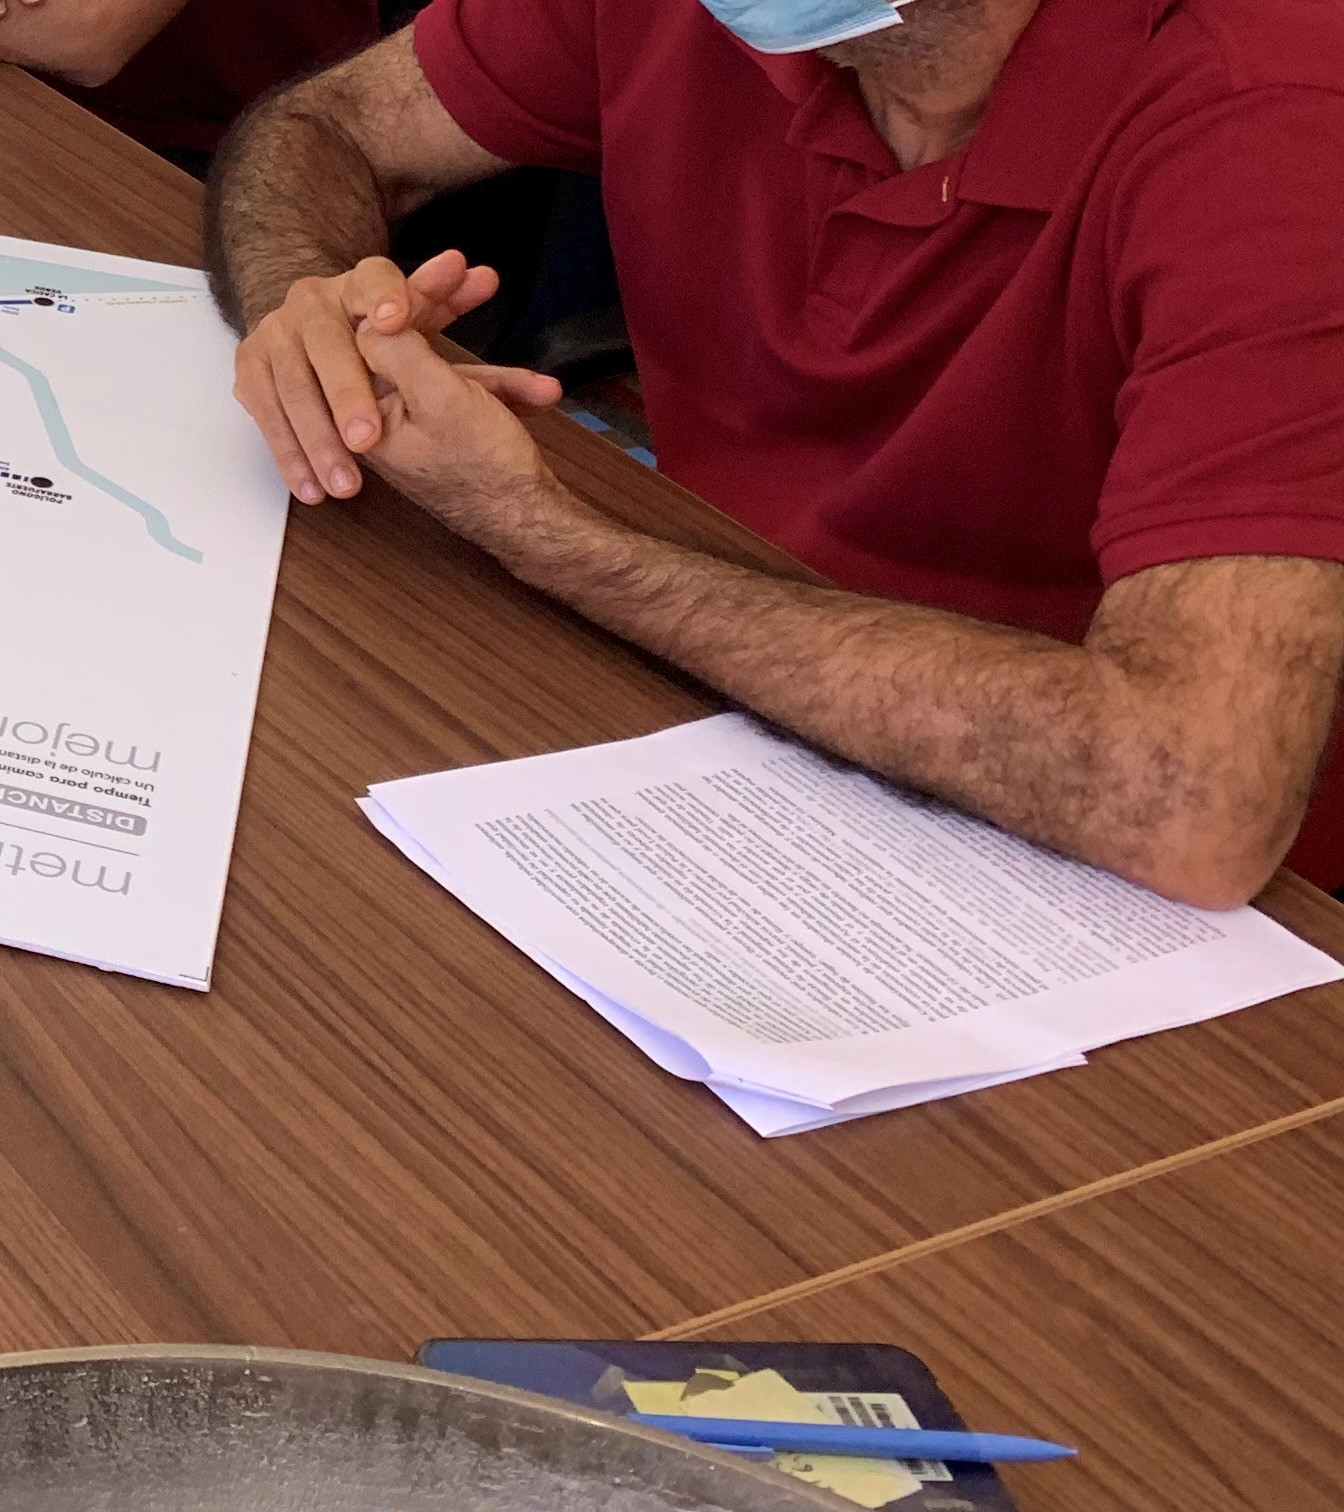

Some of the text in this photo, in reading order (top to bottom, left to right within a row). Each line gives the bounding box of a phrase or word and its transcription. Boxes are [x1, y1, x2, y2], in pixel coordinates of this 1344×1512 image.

[5, 481, 72, 501] BARRAFUERTE
[11, 489, 63, 506] POLÍGONO
[44, 760, 56, 771] la
[60, 763, 78, 776] de
[50, 774, 88, 791] para
[81, 769, 132, 789] cálculo
[135, 780, 156, 793] Un
[93, 786, 152, 807] Tiempo
